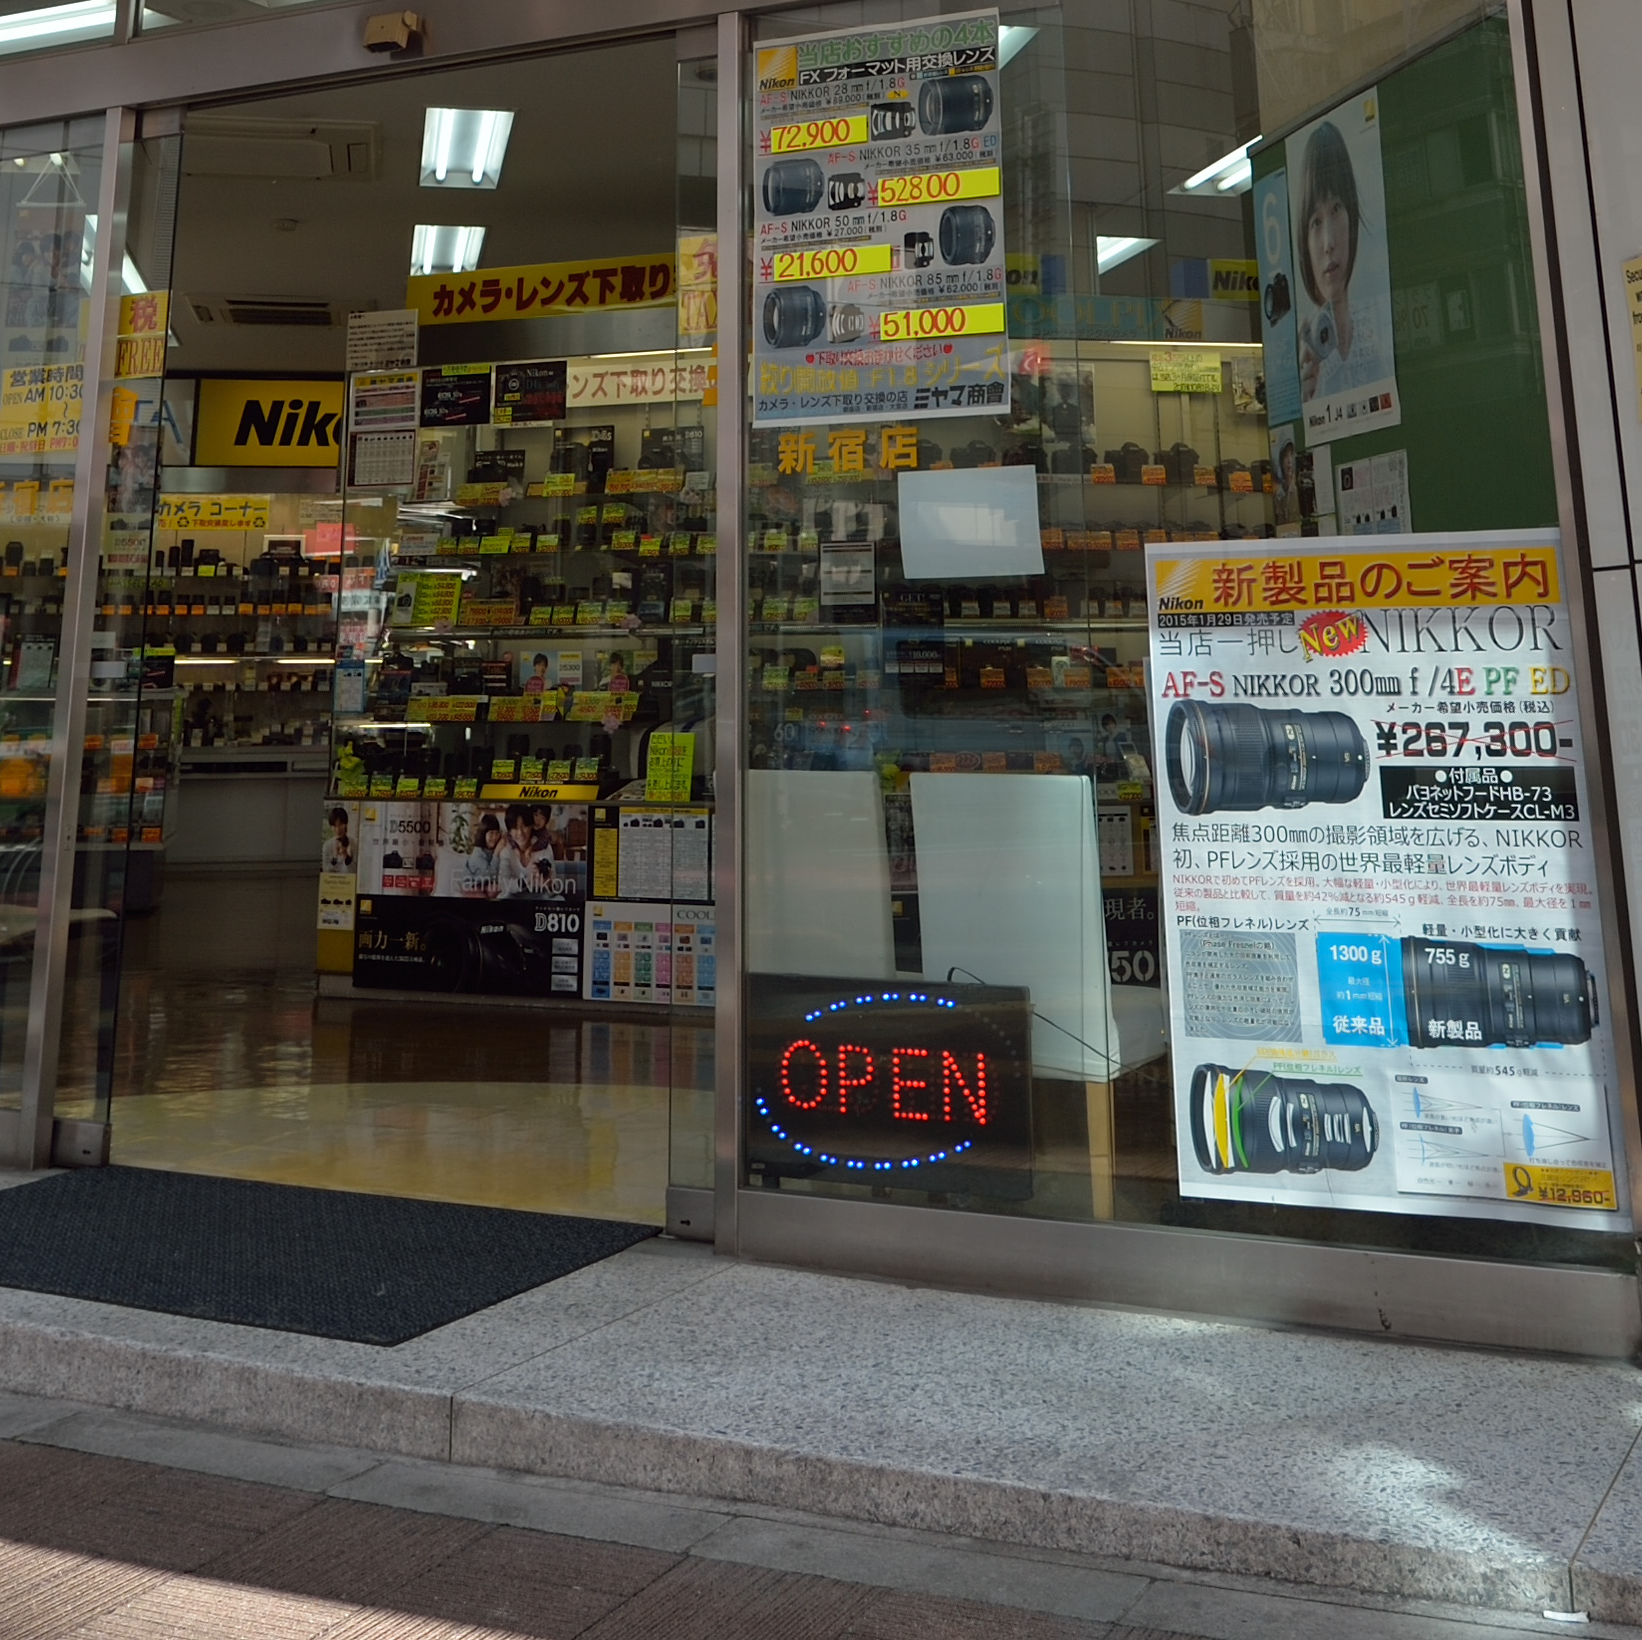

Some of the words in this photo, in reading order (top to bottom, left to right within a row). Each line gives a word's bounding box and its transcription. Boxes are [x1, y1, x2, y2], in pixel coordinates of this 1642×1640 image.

[799, 18, 995, 68] 当店おすすめの4本
[800, 72, 821, 85] FX
[824, 47, 996, 81] フォーマット用交換レンズ
[759, 77, 795, 90] Nikon
[760, 91, 788, 105] AF-S
[790, 86, 830, 101] NIKKOR
[828, 152, 856, 165] AF-S
[859, 145, 901, 161] NIKKOR
[983, 135, 997, 148] ED
[1165, 325, 1203, 339] Nikon
[118, 337, 163, 377] FREE
[10, 365, 83, 387] 営業時間
[24, 386, 45, 404] AM
[759, 391, 907, 412] カメラ・レンズ下取り交換の店
[27, 422, 48, 438] PM
[234, 399, 341, 447] Nik
[777, 425, 919, 475] 新宿店
[209, 501, 268, 516] コーナー
[1212, 552, 1550, 607] 新製品のご案内
[1158, 596, 1204, 612] Nikon
[1158, 629, 1299, 657] 当店一押し
[1160, 611, 1295, 628] 2015年1月29日発売予定
[1299, 613, 1364, 661] New
[1356, 604, 1563, 654] NIKKOR
[1161, 671, 1225, 699] AF-S
[1232, 674, 1320, 697] NIKKOR
[1484, 667, 1519, 696] PF
[1530, 667, 1571, 696] ED
[519, 785, 558, 799] Nikon
[448, 873, 508, 898] Family
[517, 873, 577, 896] Nikon
[535, 912, 580, 934] D810
[1422, 924, 1583, 942] 軽量・小型化に大きく貢献
[1333, 1015, 1386, 1036] 従来品
[1428, 1019, 1482, 1041] 新製品
[781, 1039, 987, 1125] OPEN
